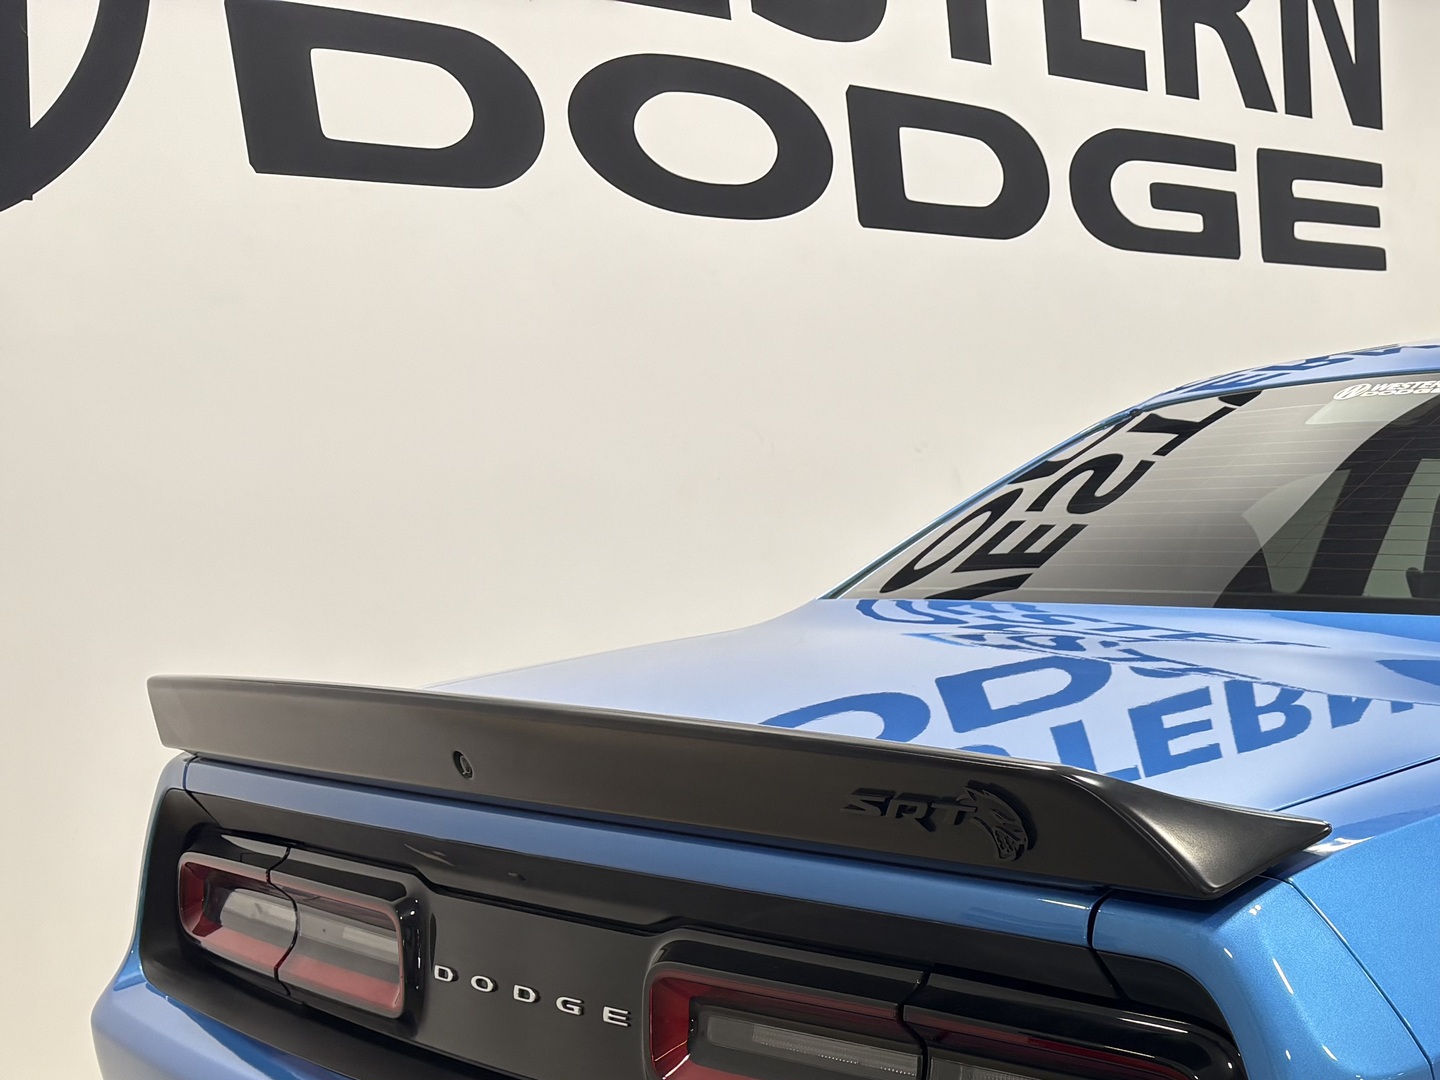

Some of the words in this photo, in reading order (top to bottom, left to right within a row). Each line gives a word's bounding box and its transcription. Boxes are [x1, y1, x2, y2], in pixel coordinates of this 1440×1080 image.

[225, 0, 1387, 271] DODGE
[840, 788, 978, 832] SRT
[434, 964, 629, 1027] DODGE
